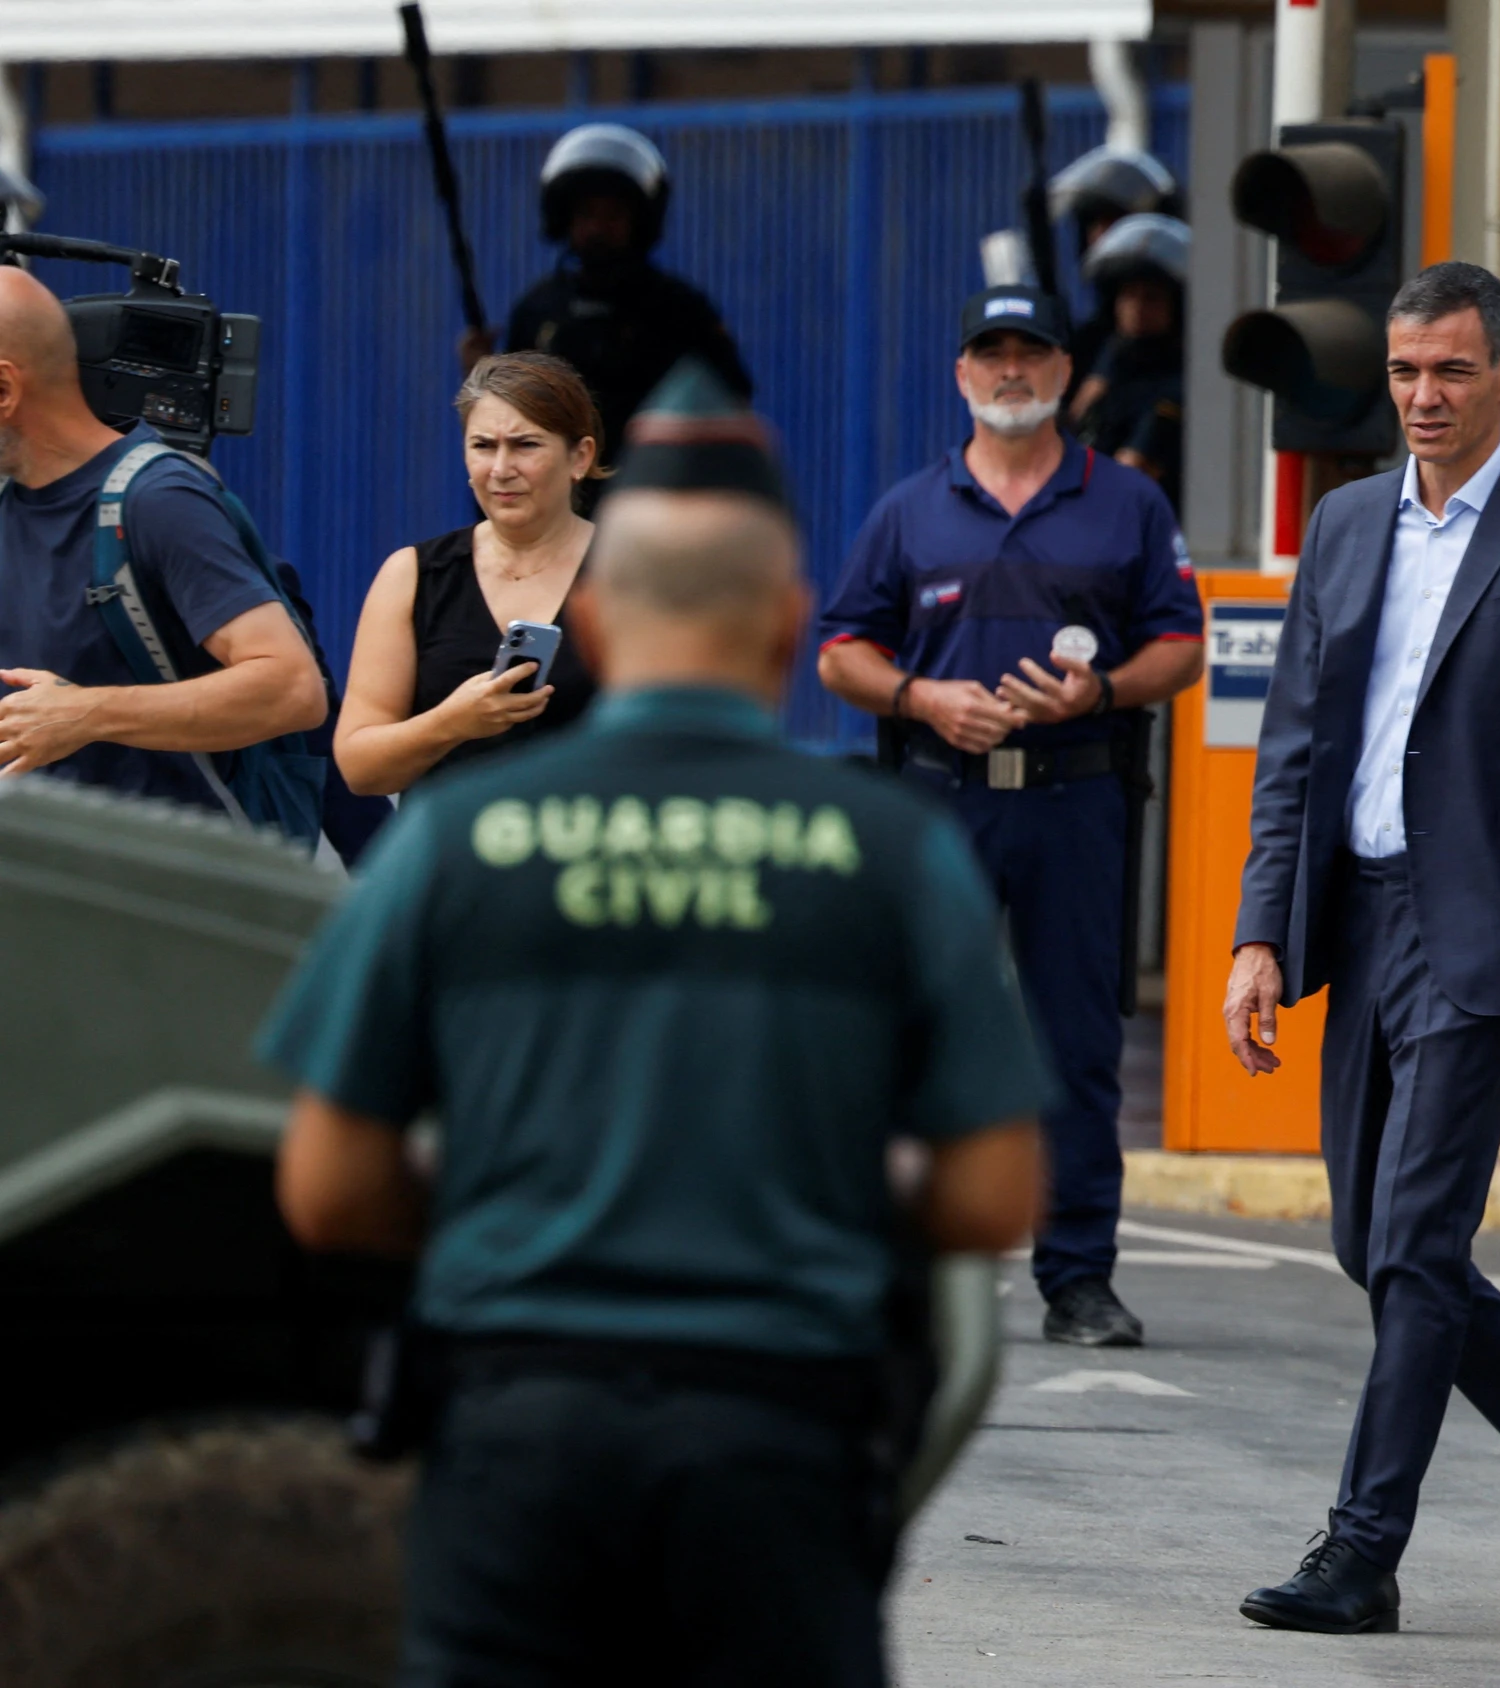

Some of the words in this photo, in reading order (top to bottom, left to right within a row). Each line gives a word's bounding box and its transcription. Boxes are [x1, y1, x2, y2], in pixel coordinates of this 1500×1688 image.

[1213, 630, 1278, 655] Trab
[472, 795, 860, 875] GUARDIA
[555, 862, 772, 929] CIVIL
